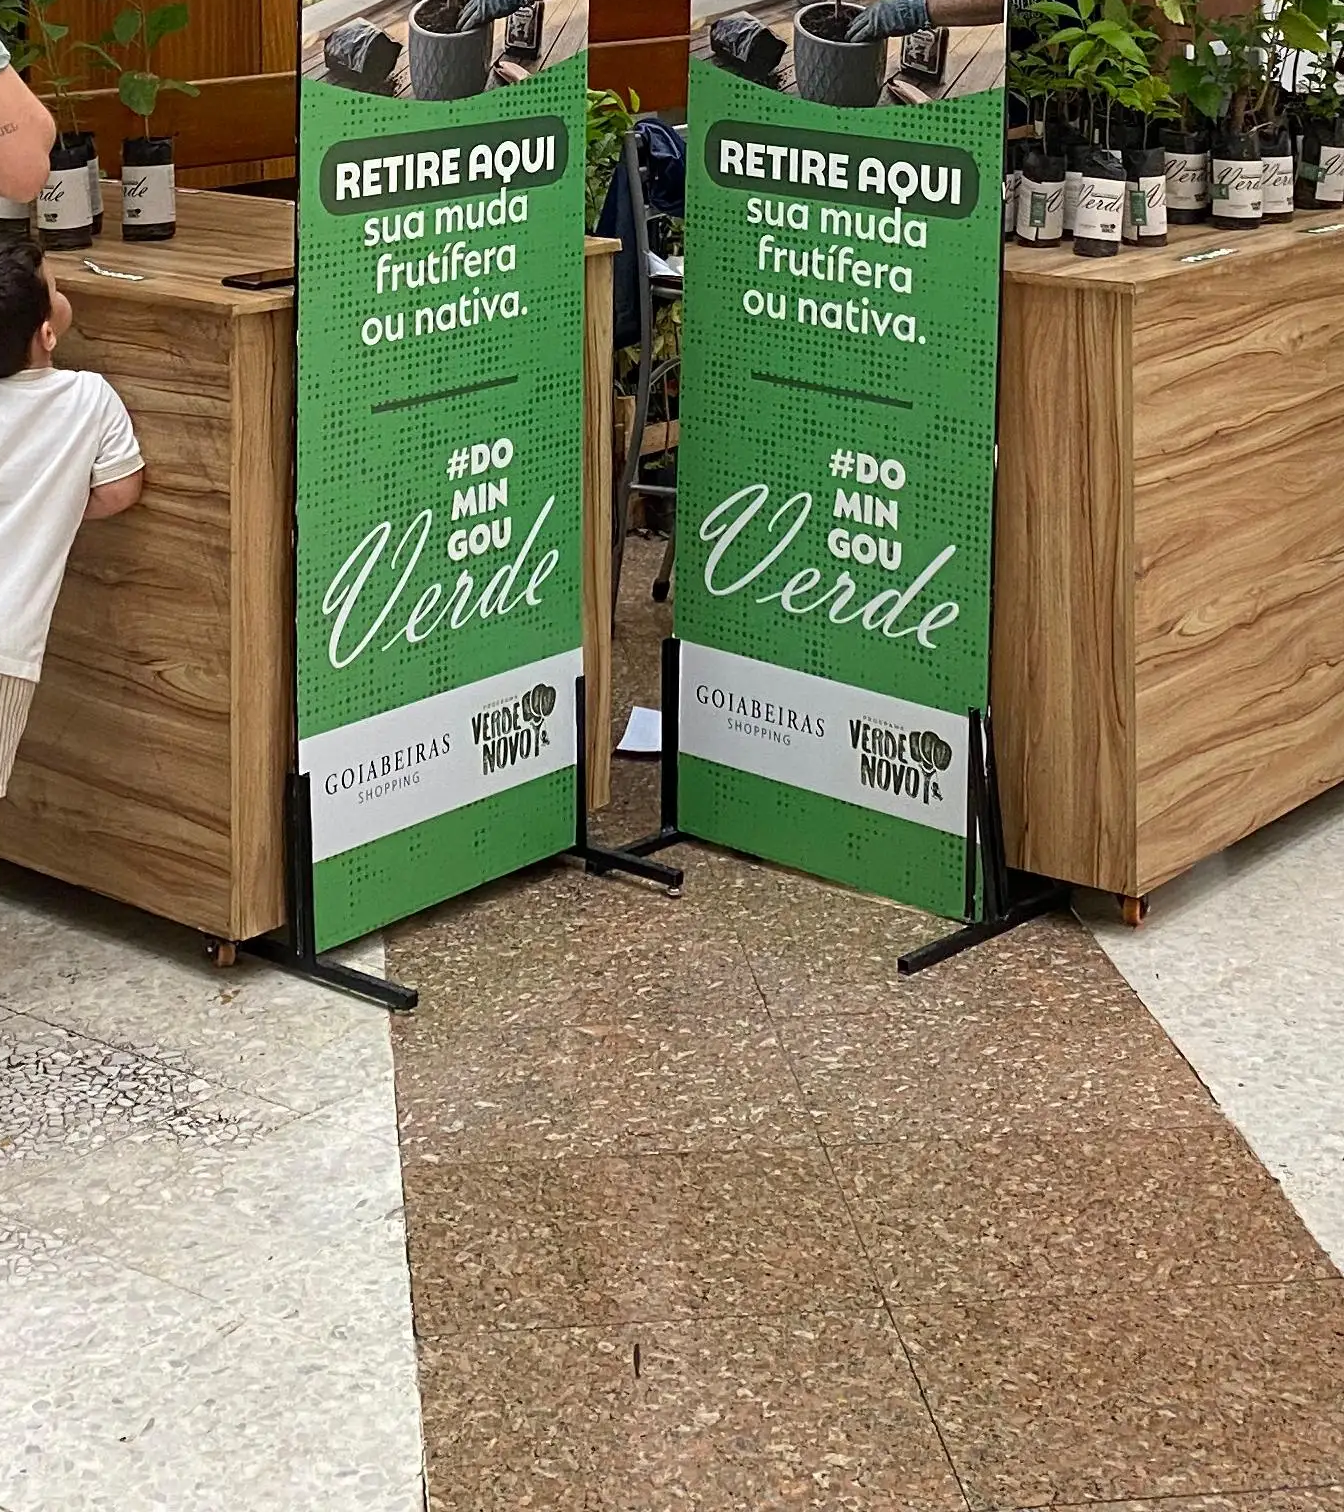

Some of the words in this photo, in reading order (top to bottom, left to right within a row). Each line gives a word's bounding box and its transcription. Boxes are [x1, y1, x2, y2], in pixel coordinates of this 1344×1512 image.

[335, 146, 461, 201] RETIRE
[467, 134, 556, 184] AQUI
[719, 139, 850, 190] RETIRE
[858, 156, 962, 206] AQUI
[363, 209, 425, 248] sua
[434, 187, 529, 235] muda
[746, 196, 810, 232] sua
[820, 206, 928, 248] muda
[376, 240, 517, 294] frutífera
[758, 234, 914, 295] frutífera
[361, 309, 405, 347] ou
[414, 286, 529, 337] nativa.
[742, 288, 787, 321] ou
[797, 296, 927, 346] nativa.
[446, 437, 514, 482] #DO
[828, 447, 907, 491] #DO
[451, 477, 509, 521] MIN
[833, 487, 901, 532] MIN
[447, 517, 513, 563] GOU
[827, 528, 904, 572] GOU
[322, 494, 560, 670] Verde
[699, 483, 961, 650] Verde
[471, 701, 522, 746] VERDE
[695, 685, 825, 738] GOIABEIRAS
[727, 717, 792, 746] SHOPPING
[324, 731, 453, 797] GOIABEIRAS
[482, 728, 532, 775] NOVO
[849, 719, 909, 765] VERDE
[358, 769, 421, 805] SHOPPING
[860, 753, 920, 799] NOVO
